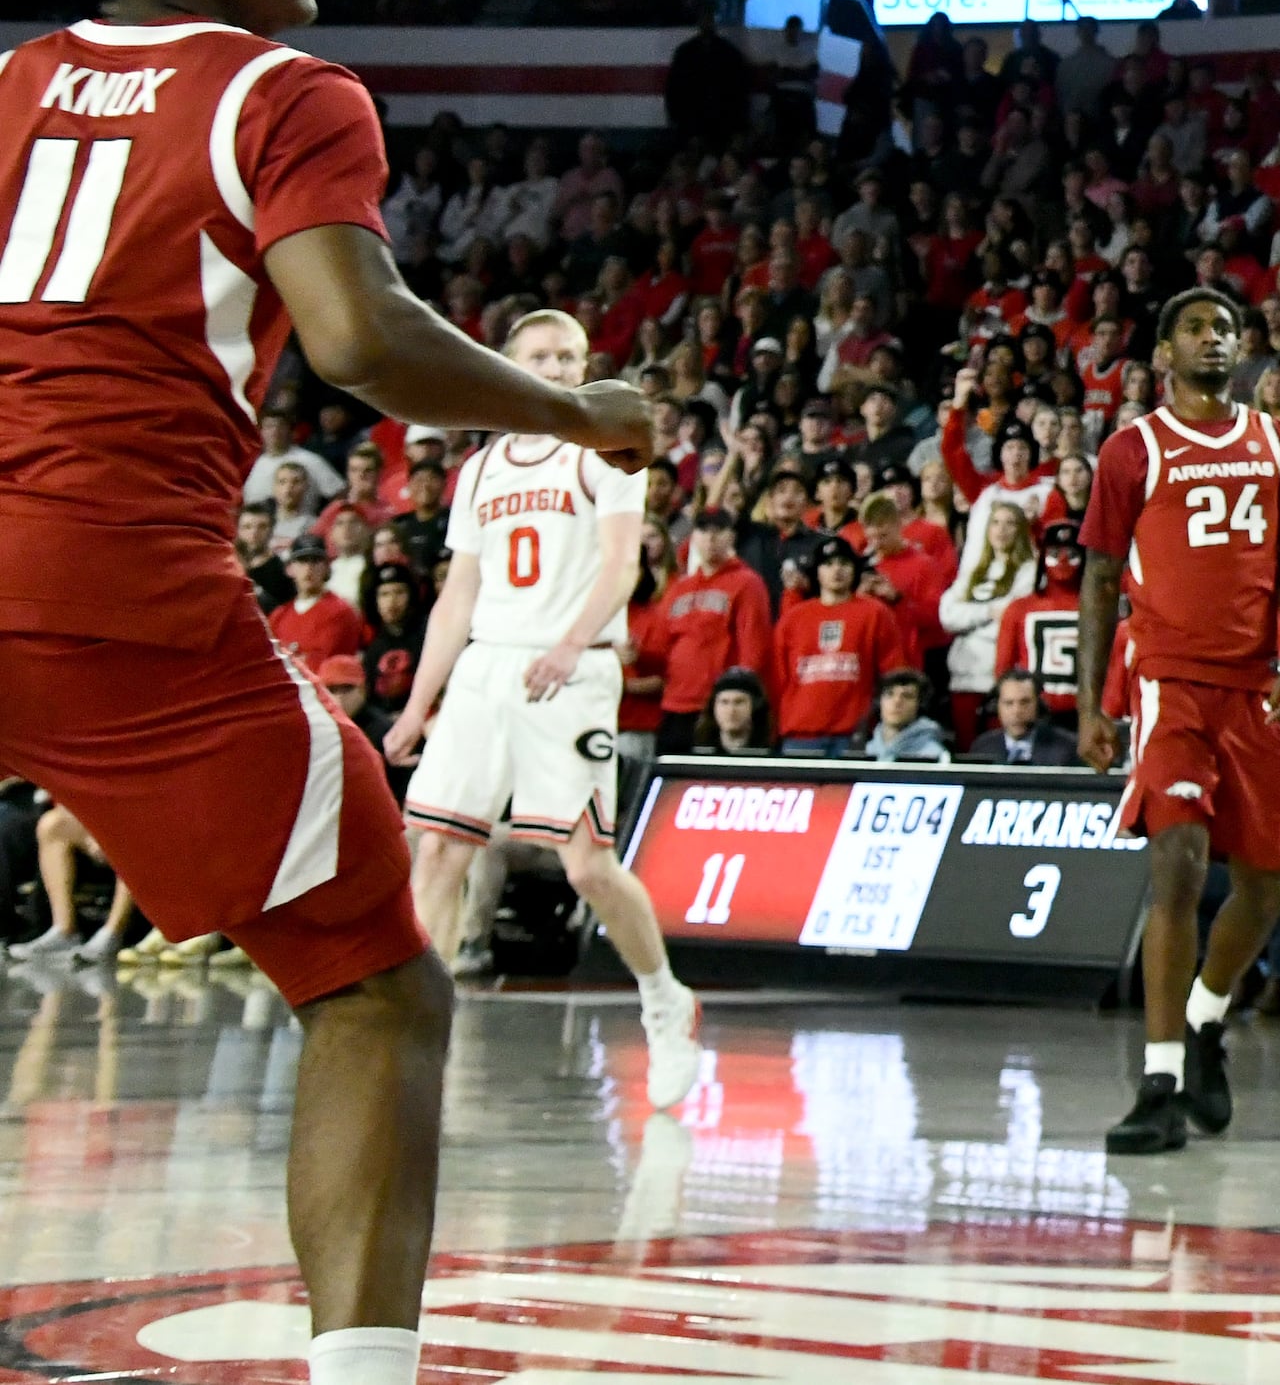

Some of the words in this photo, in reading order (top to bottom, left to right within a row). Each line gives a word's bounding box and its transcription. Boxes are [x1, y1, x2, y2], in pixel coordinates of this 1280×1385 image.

[40, 63, 177, 117] KNOX
[0, 138, 132, 304] 11
[1168, 461, 1275, 484] ARKANSAS
[478, 488, 577, 527] GEORGIA
[1185, 483, 1268, 547] 24
[508, 526, 540, 588] 0
[674, 785, 815, 834] GEORGIA
[851, 793, 949, 836] 16:04
[961, 799, 1148, 851] ARKANS
[685, 852, 746, 925] 11
[1009, 863, 1062, 939] 3
